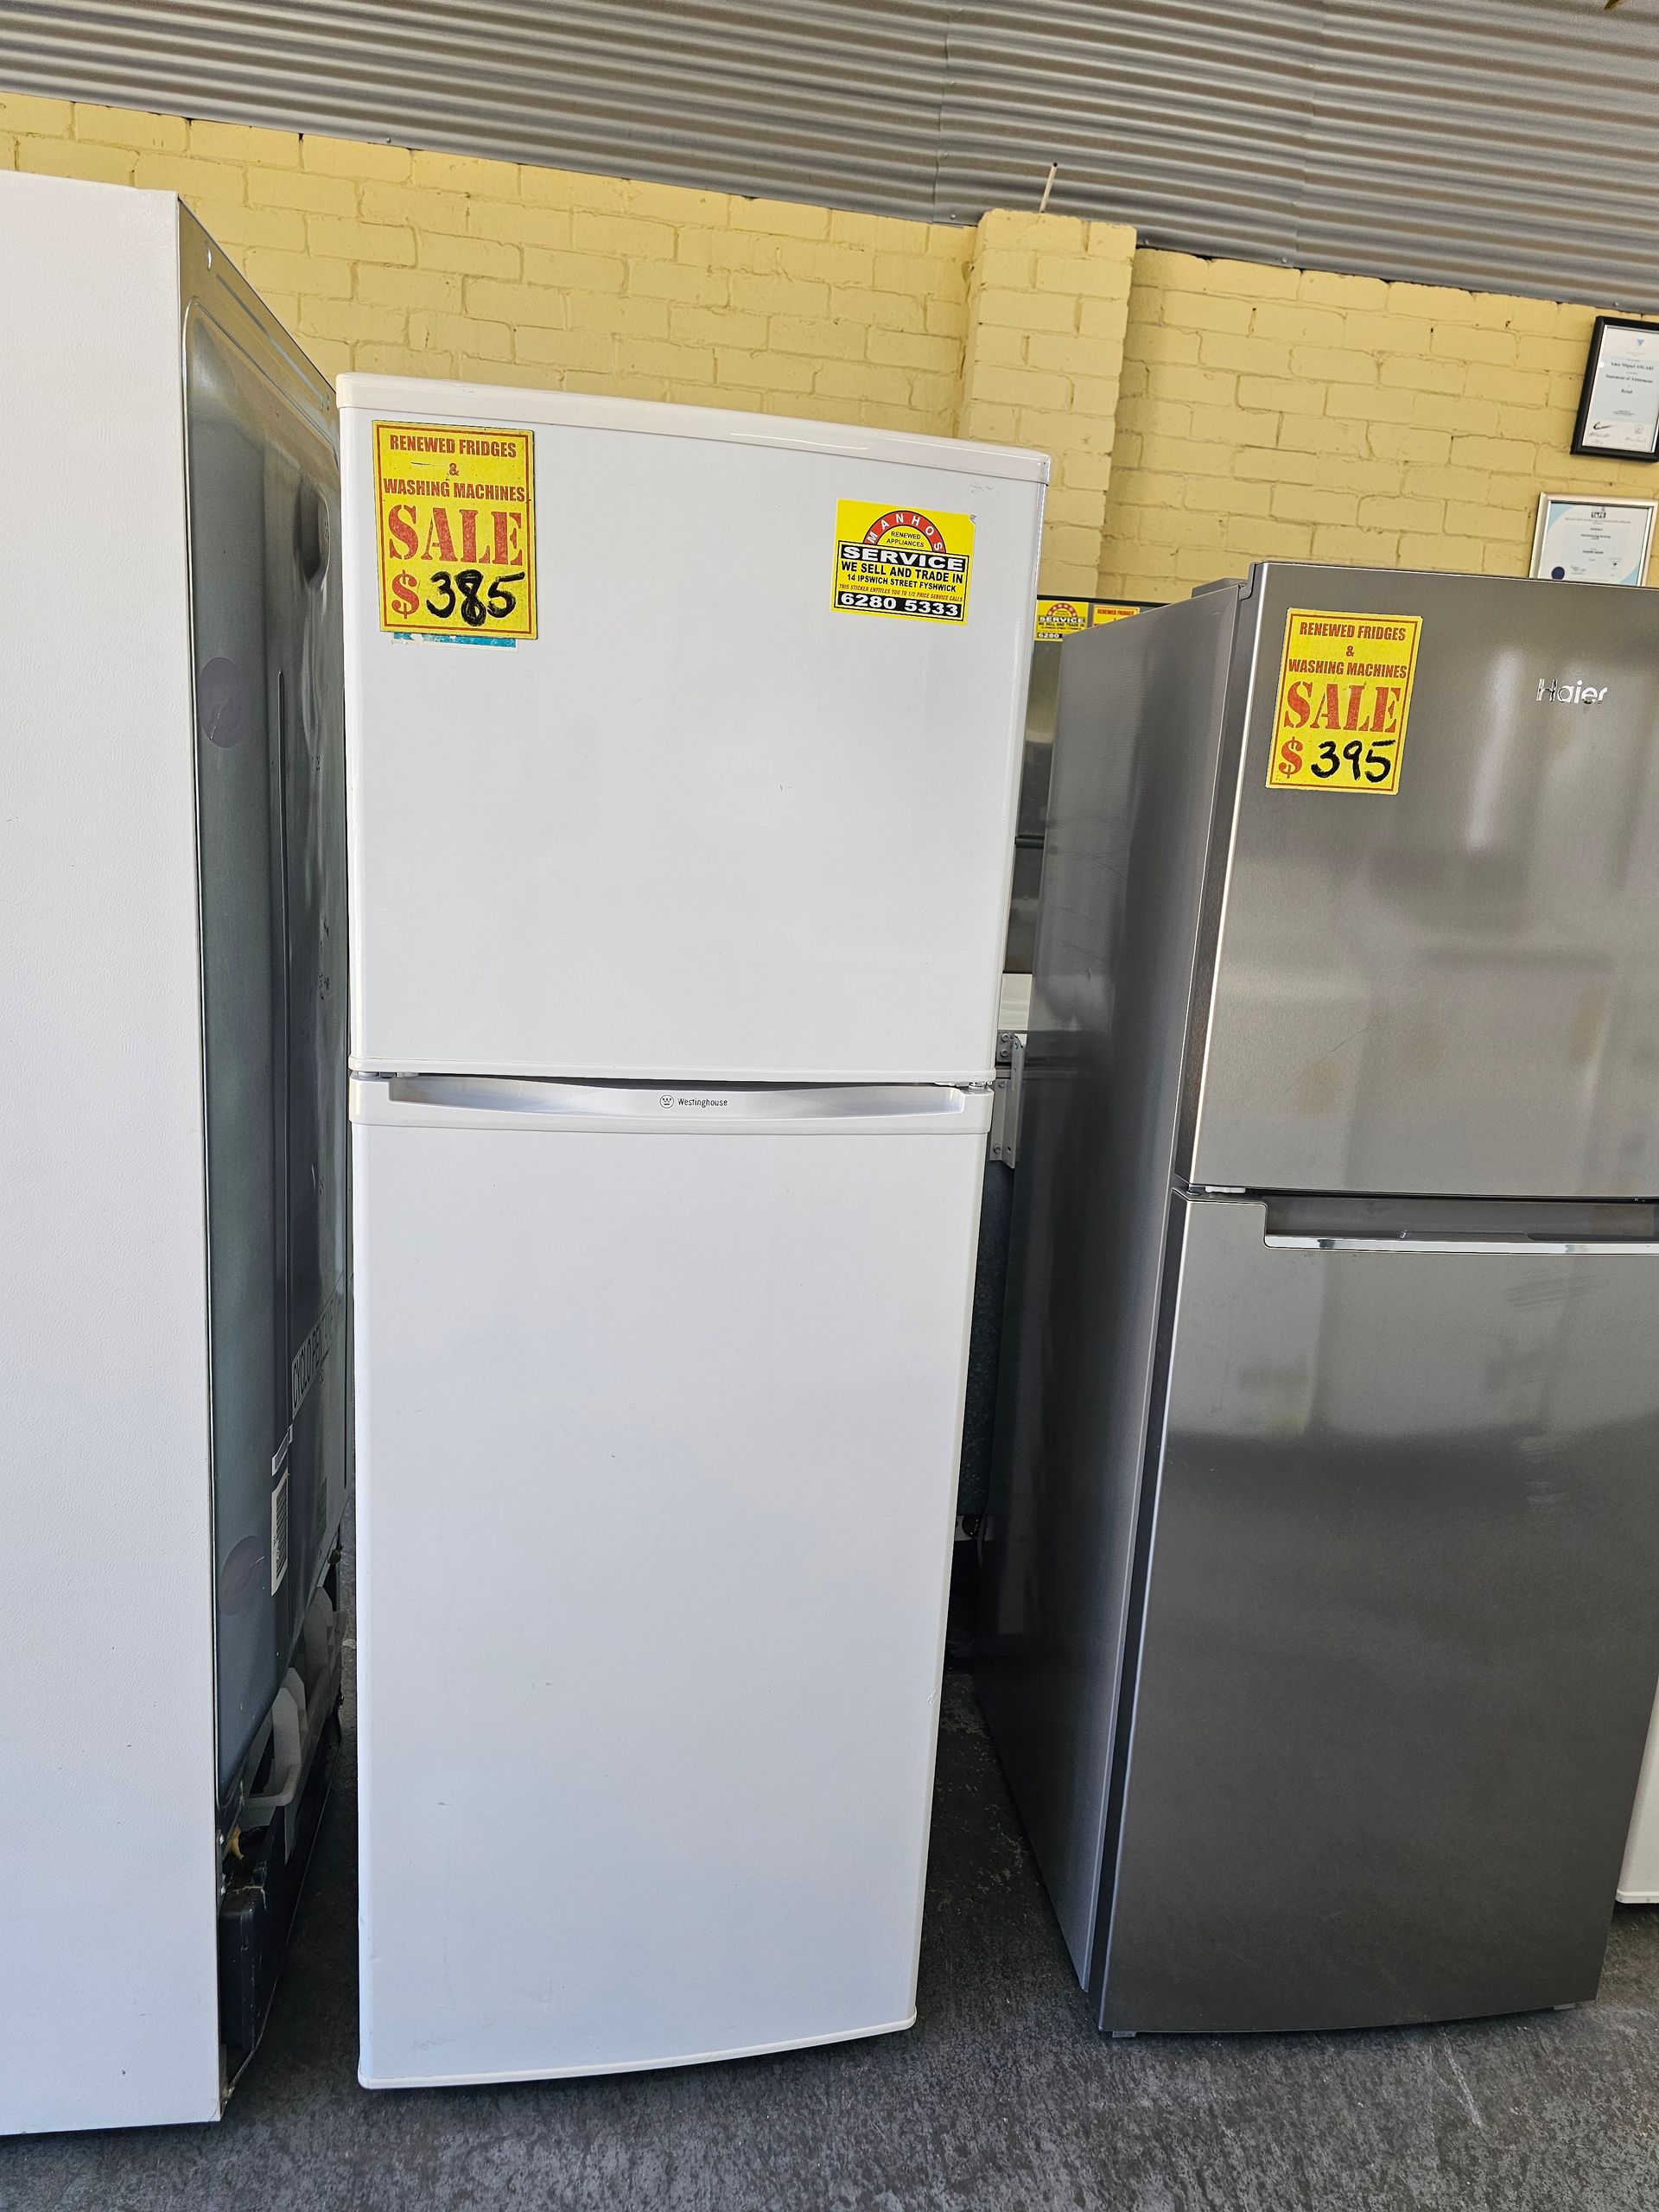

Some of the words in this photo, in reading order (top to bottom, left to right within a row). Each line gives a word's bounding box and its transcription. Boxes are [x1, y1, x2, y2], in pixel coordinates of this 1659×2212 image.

[390, 435, 455, 454] RENEWED
[459, 439, 517, 458] FRIDGES
[448, 462, 460, 476] &
[383, 478, 450, 498] WASHING
[454, 482, 525, 502] MACHINES
[388, 504, 523, 566] SALE
[867, 513, 944, 551] MANHOS
[886, 537, 925, 548] APPLIANCES
[891, 531, 921, 540] RENEWED
[842, 546, 963, 571] SERVICE
[841, 561, 857, 572] WE
[861, 563, 887, 575] SELL
[890, 567, 912, 578] AND
[915, 569, 949, 582] TRADE
[952, 573, 963, 584] IN
[857, 575, 888, 585] IPSWICH
[890, 579, 917, 588] STREET
[919, 582, 957, 593] FYSHWICK
[391, 569, 420, 619] $
[426, 569, 525, 626] 385
[841, 593, 897, 609] 6280
[904, 600, 958, 616] 5333
[1300, 621, 1356, 639] RENEWED
[1357, 625, 1406, 641] FRIDGES
[1345, 645, 1355, 657] &
[1288, 658, 1344, 676] WASHING
[1346, 662, 1408, 678] MACHINES
[1535, 678, 1607, 705] Haier
[1283, 681, 1401, 734] SALE
[1278, 736, 1304, 779] $
[1310, 740, 1396, 783] 395
[677, 1097, 728, 1109] Westinghouse
